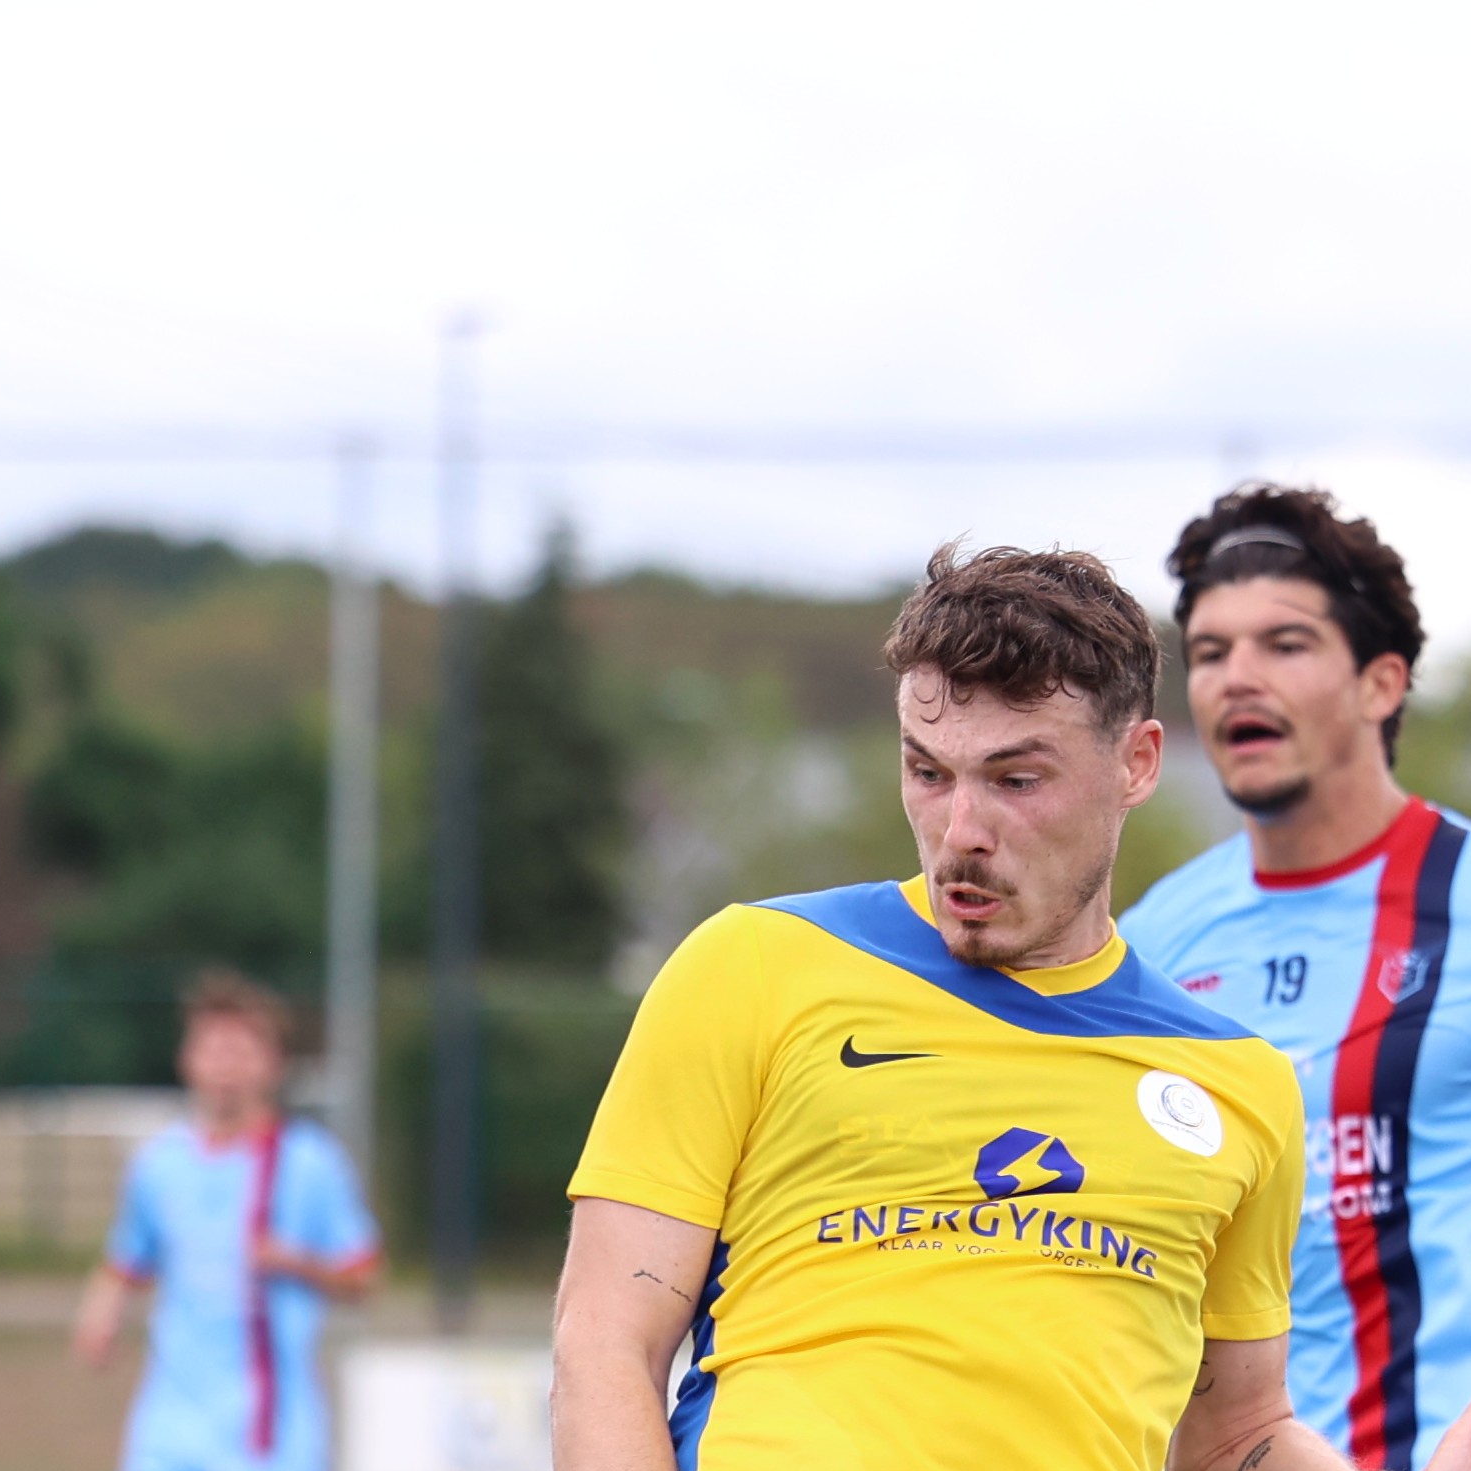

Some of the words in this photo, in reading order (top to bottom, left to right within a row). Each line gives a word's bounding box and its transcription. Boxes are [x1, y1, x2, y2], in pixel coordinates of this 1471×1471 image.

[1263, 954, 1308, 1004] 19
[817, 1201, 1158, 1280] ENERGYKING
[877, 1238, 944, 1252] KLAAR
